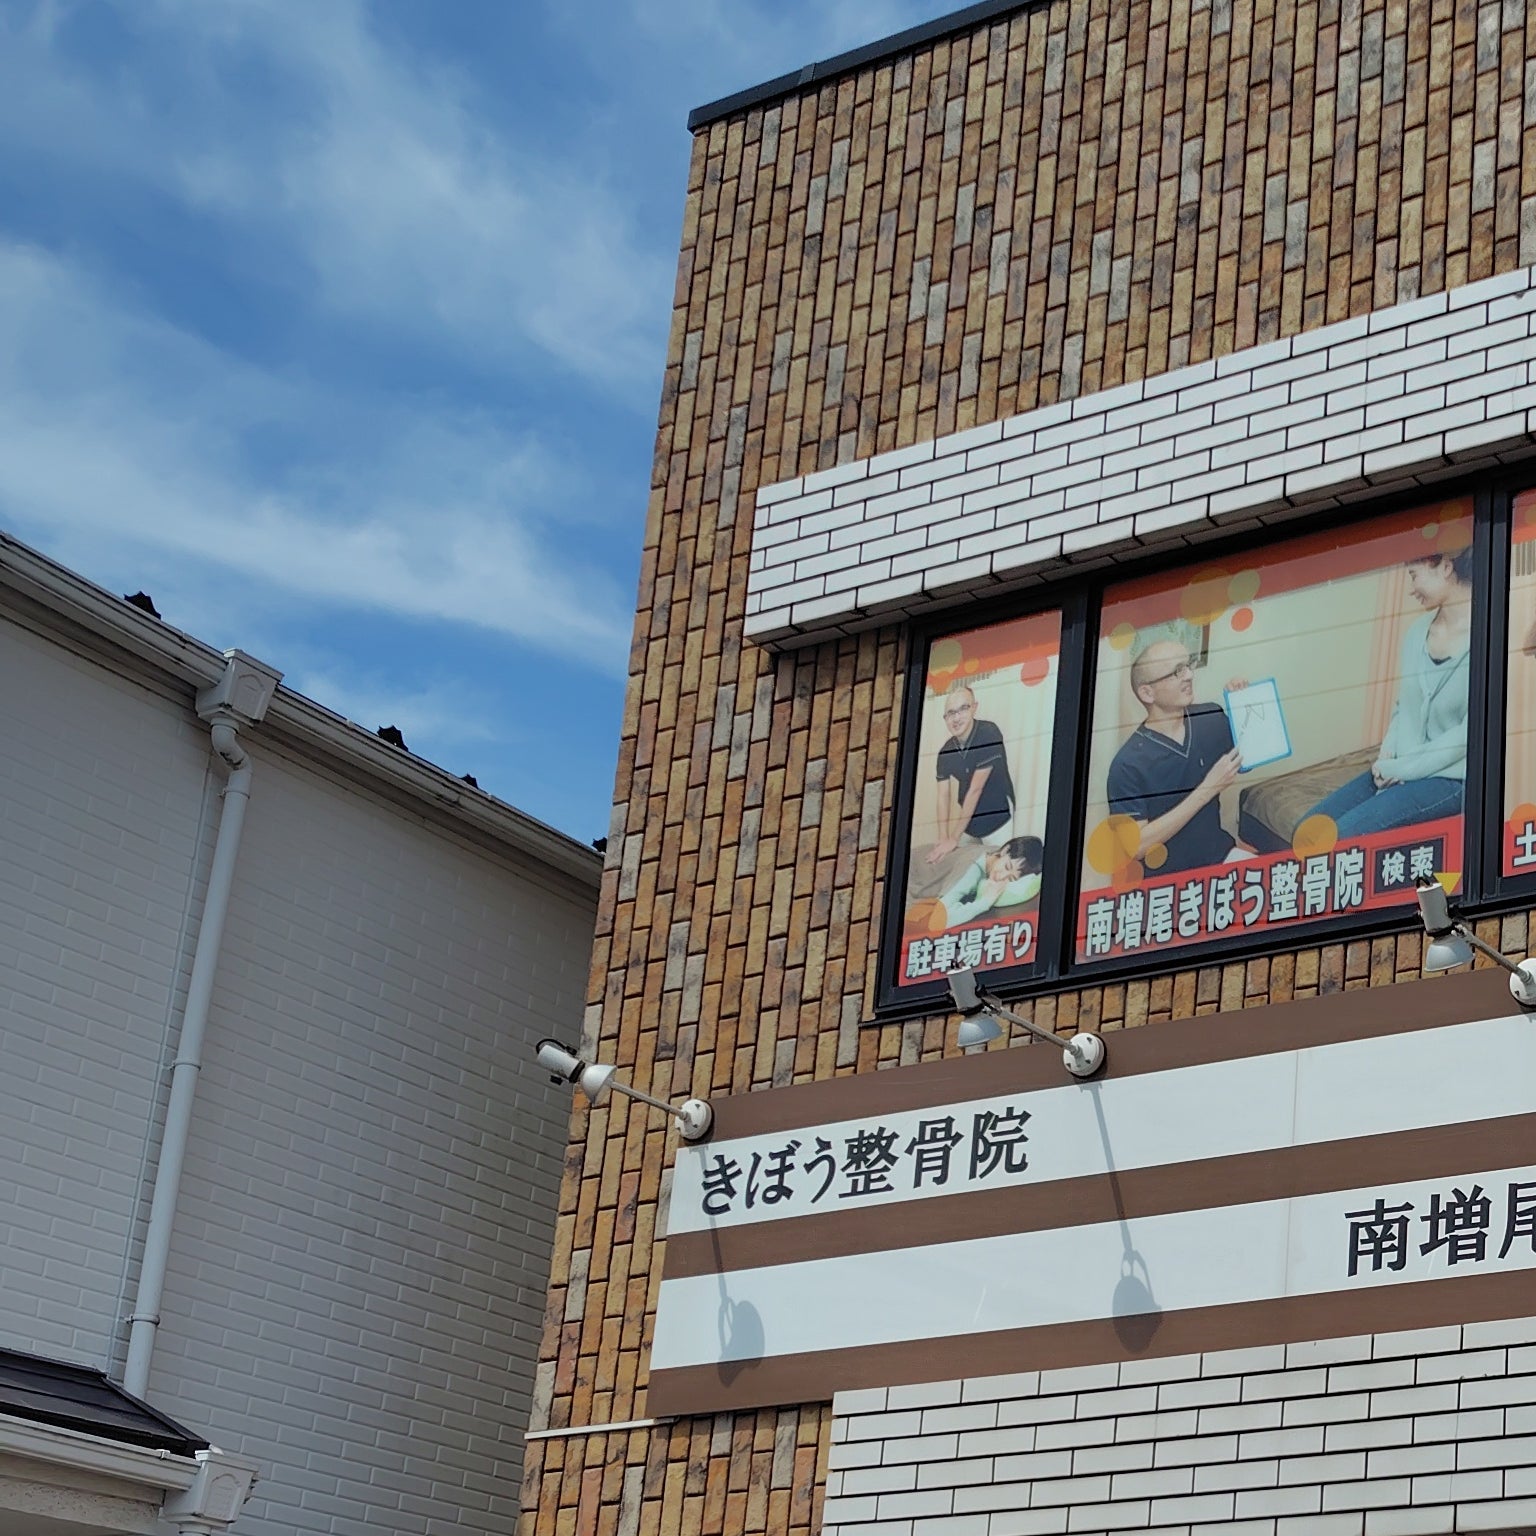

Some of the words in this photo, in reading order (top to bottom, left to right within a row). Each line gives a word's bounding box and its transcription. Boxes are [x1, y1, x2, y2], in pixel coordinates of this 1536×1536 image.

[906, 921, 1033, 978] 駐車場有り
[1085, 849, 1364, 957] 南増尾きぼう整骨院
[1381, 846, 1435, 887] 検索
[701, 1106, 1032, 1215] きぼう整骨院
